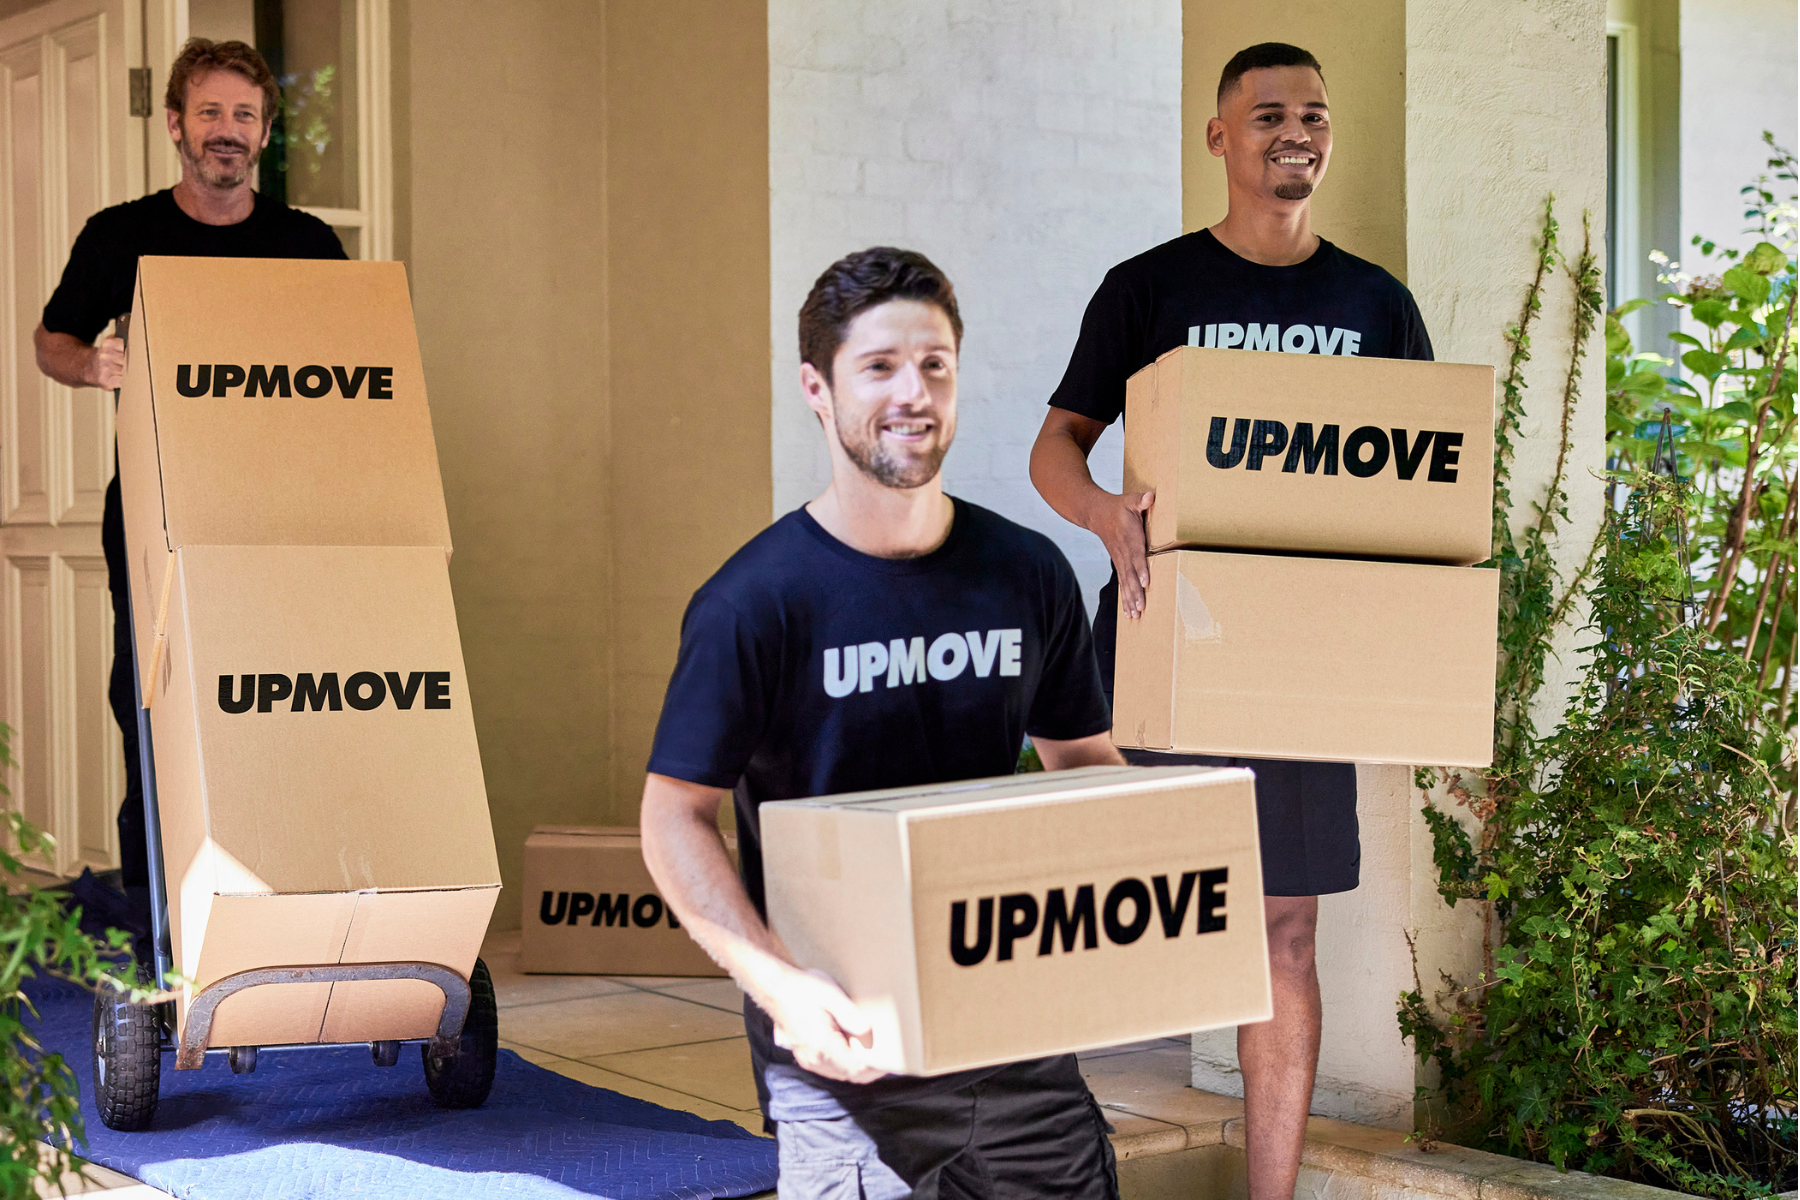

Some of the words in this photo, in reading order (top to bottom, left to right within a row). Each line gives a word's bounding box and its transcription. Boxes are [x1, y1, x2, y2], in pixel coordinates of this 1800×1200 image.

[1188, 323, 1362, 357] UPMOVE
[176, 364, 393, 400] UPMOVE
[1205, 416, 1464, 483] UPMOVE
[823, 629, 1022, 698] UPMOVE
[218, 671, 451, 714] UPMOVE
[949, 867, 1229, 967] UPMOVE
